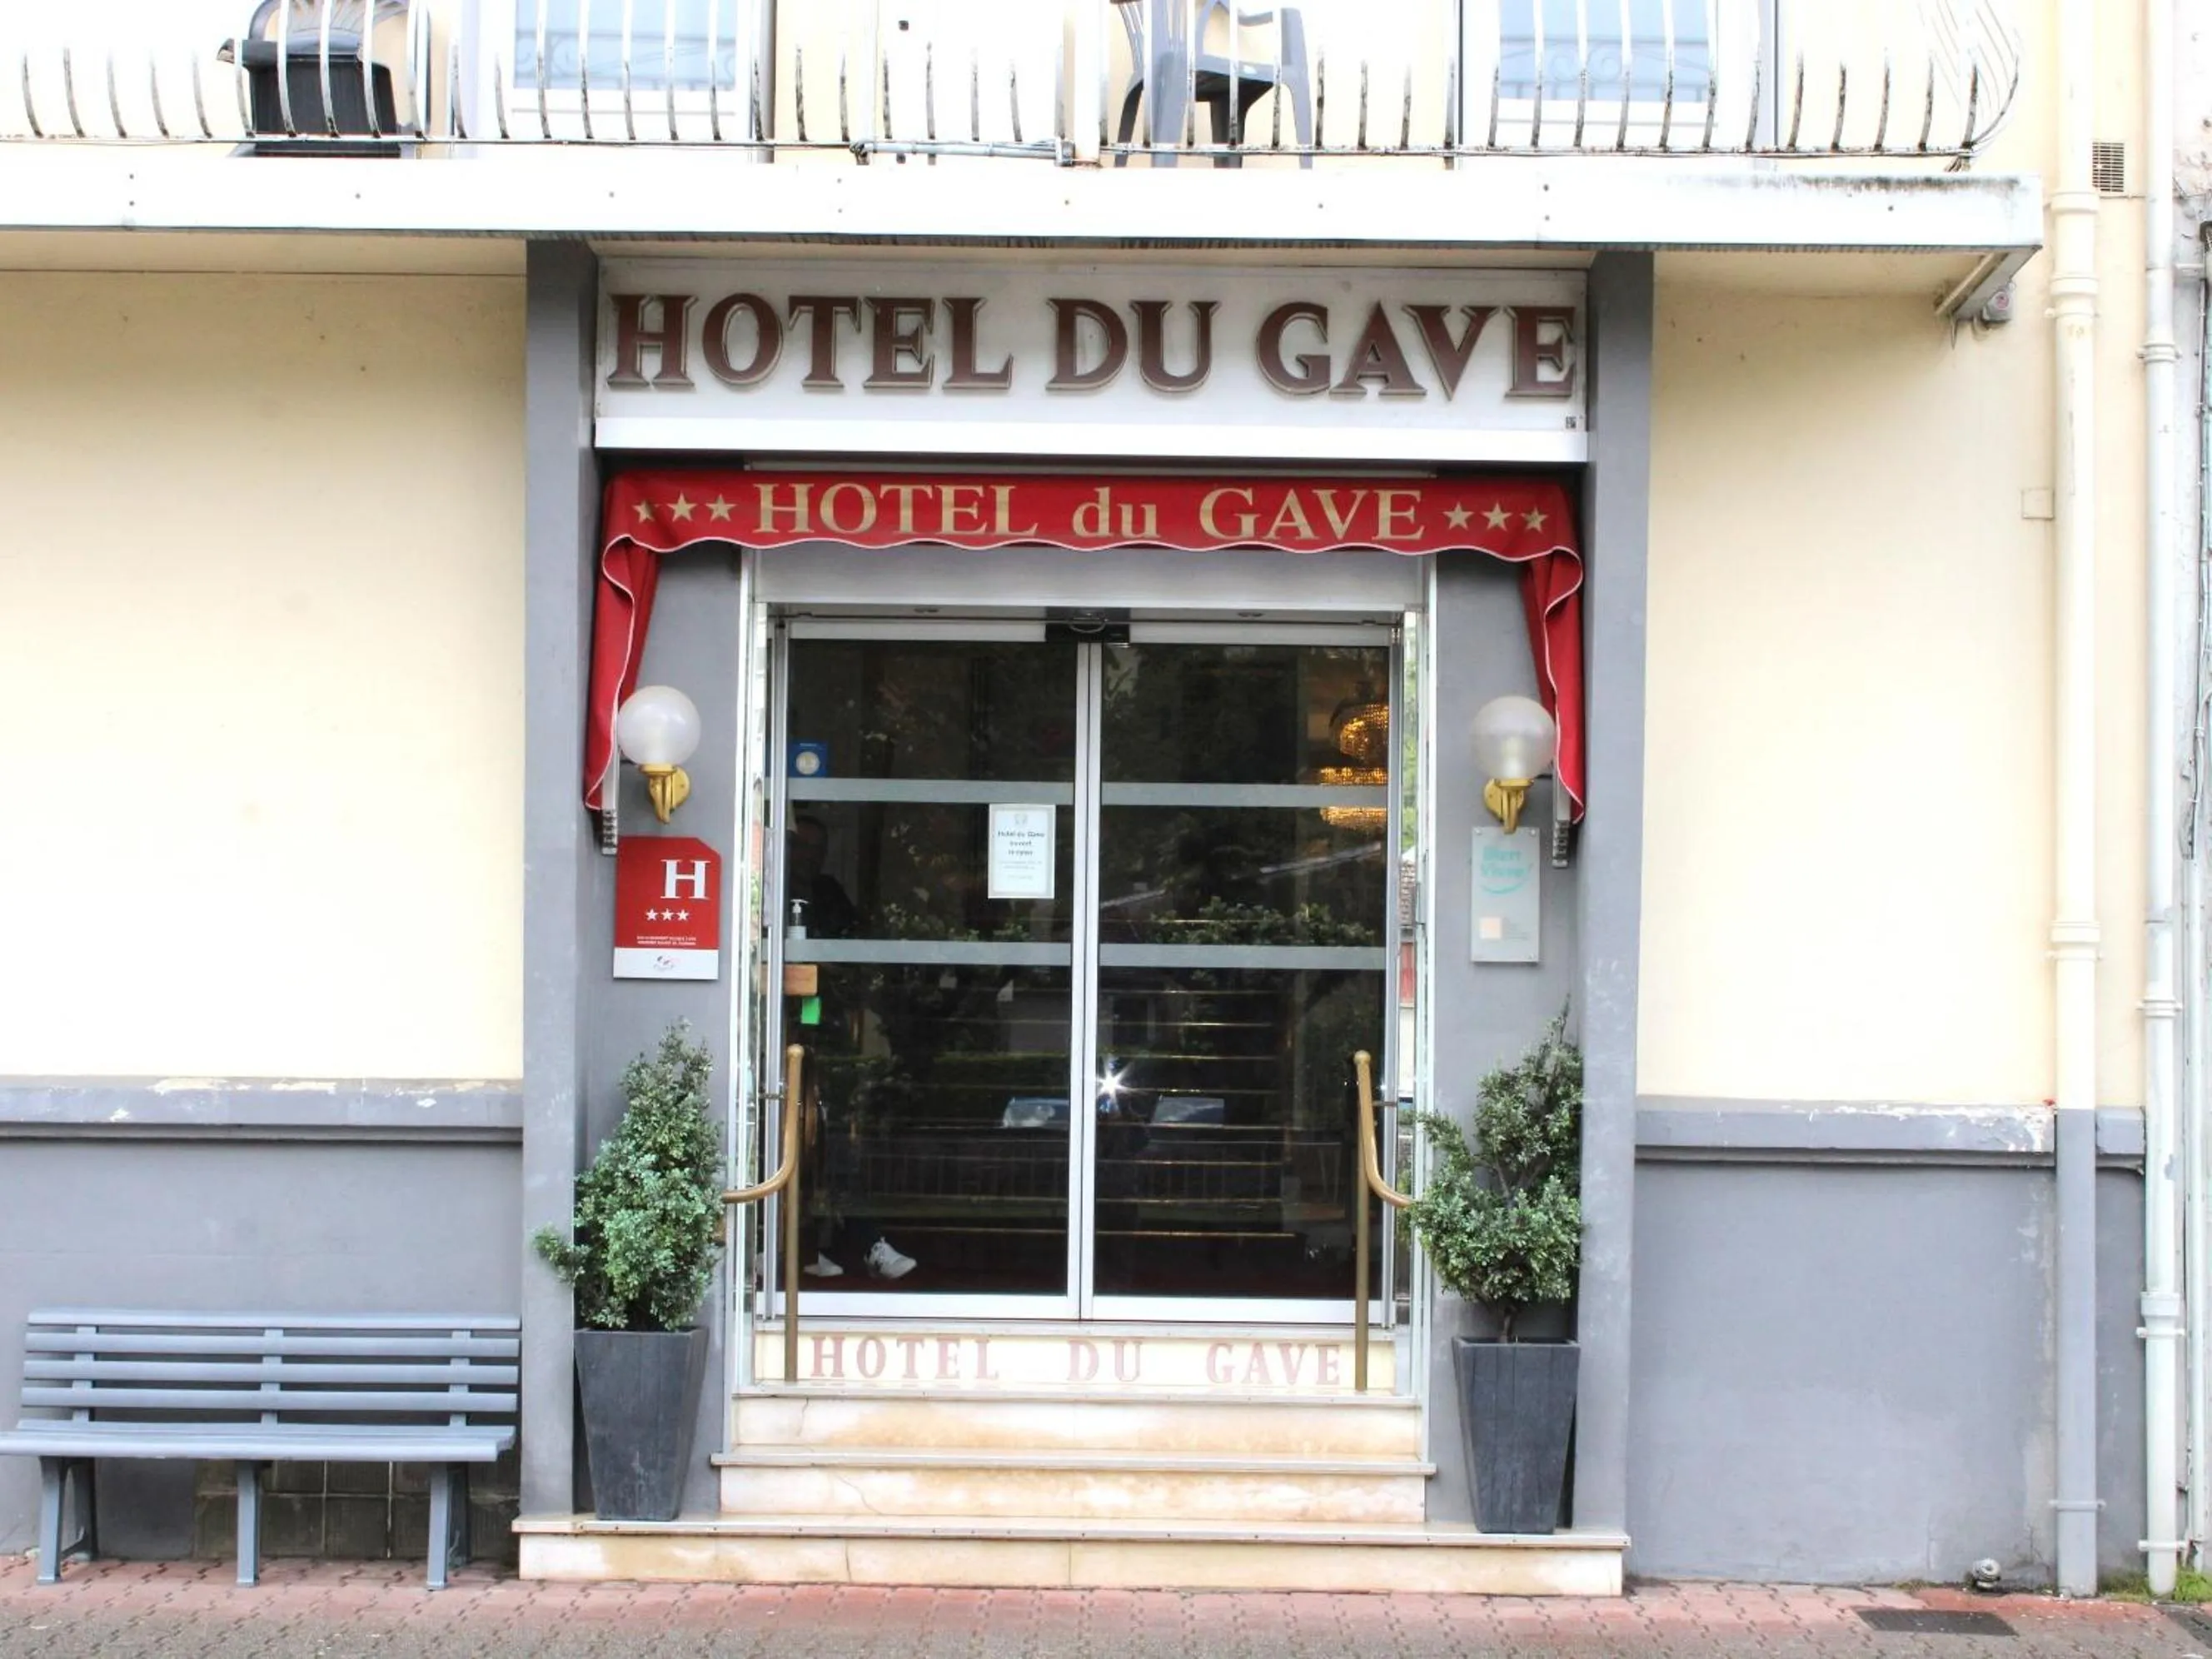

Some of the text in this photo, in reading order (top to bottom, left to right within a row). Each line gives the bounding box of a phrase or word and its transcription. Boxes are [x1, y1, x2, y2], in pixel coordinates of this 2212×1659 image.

[607, 292, 1577, 401] HOTEL DU GAVE
[753, 481, 1425, 541] HOTEL du GAVE
[660, 859, 711, 899] H
[810, 1336, 1341, 1386] HOTEL DU GAVE
